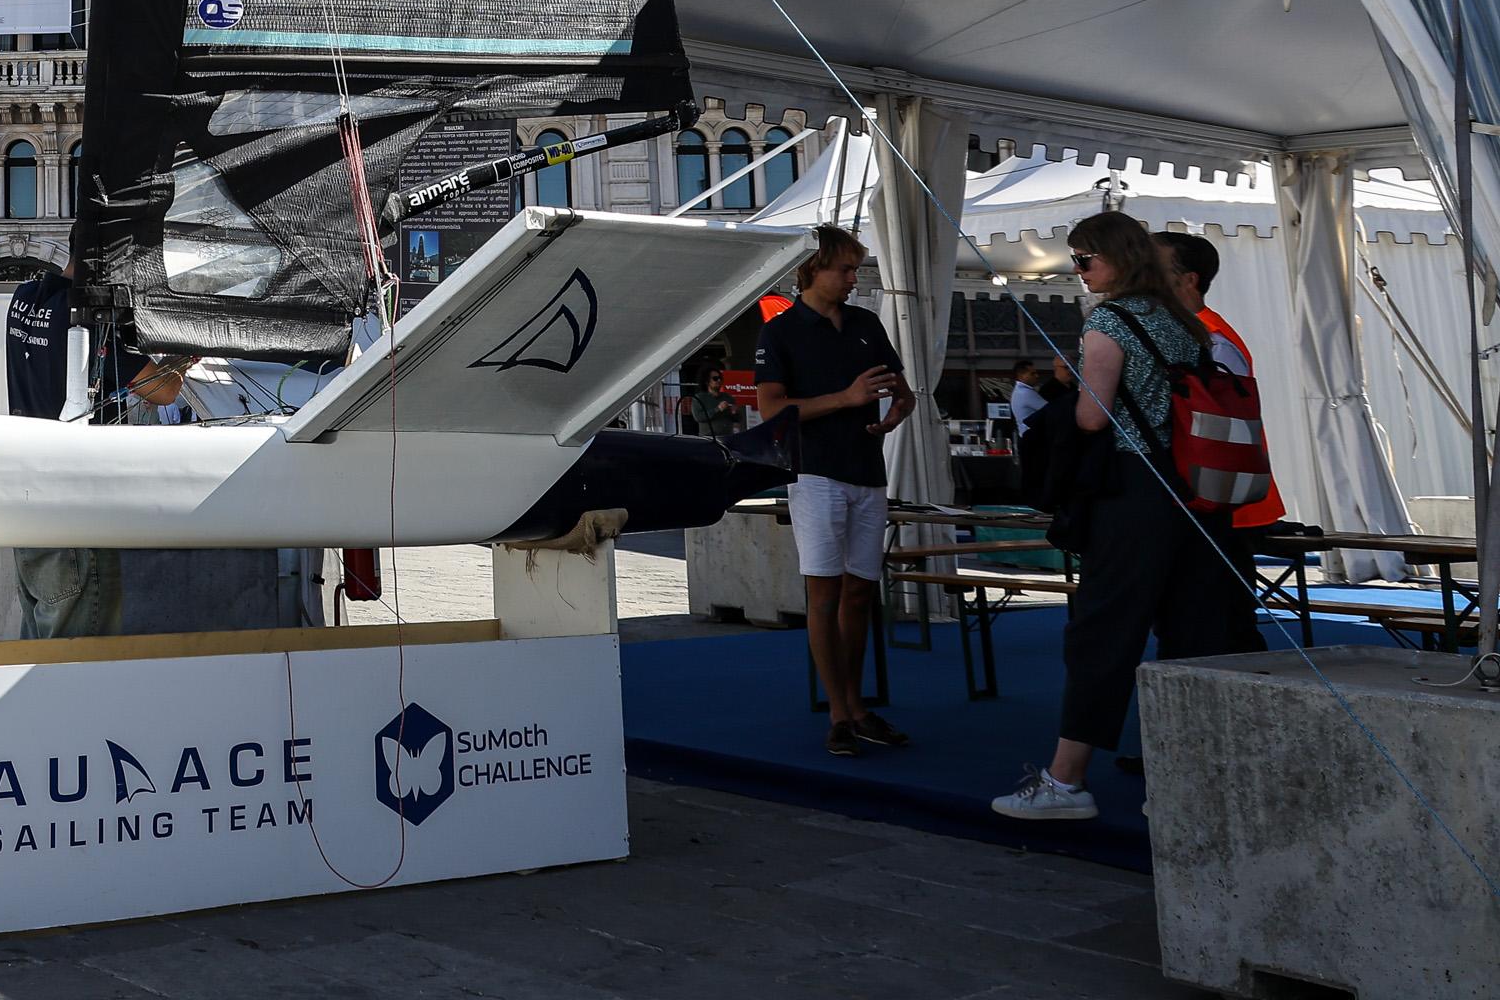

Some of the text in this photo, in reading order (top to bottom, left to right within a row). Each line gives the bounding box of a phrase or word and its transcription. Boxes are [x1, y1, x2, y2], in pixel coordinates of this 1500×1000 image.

[512, 154, 546, 170] COMPOSITES
[548, 142, 572, 159] WD-40
[408, 170, 470, 206] armare
[444, 185, 470, 201] ropes
[458, 724, 548, 753] SuMoth
[458, 754, 592, 786] CHALLENGE
[202, 798, 312, 834] TEAM
